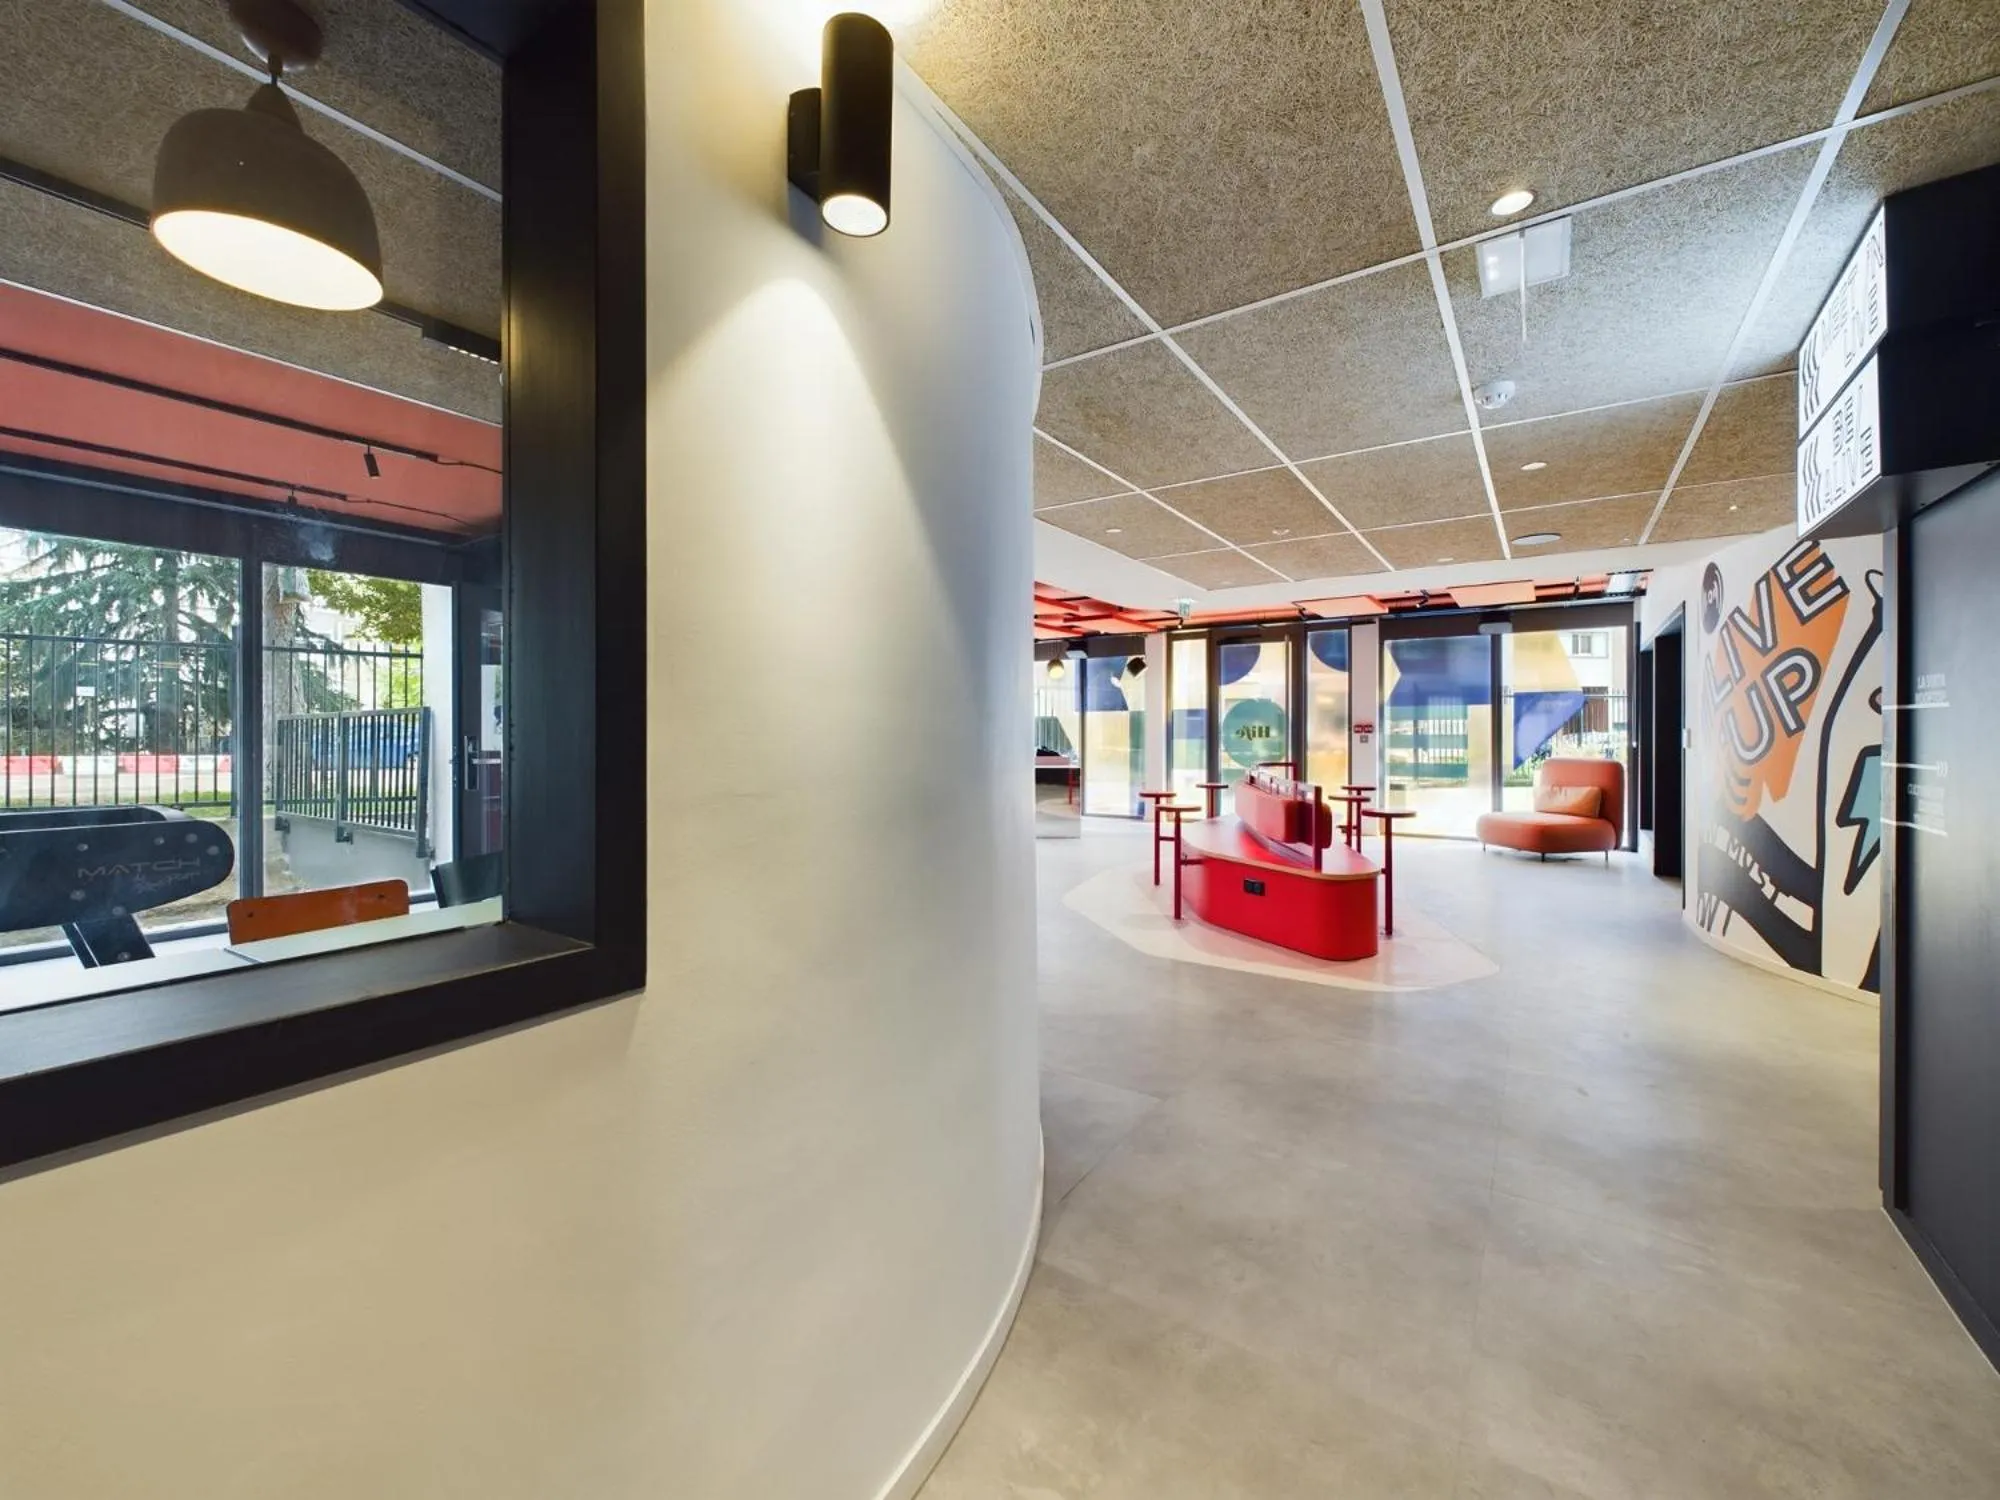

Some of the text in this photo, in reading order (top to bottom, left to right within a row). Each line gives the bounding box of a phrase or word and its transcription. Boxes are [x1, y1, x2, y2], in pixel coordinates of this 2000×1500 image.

[1705, 538, 1850, 712] LIVE
[1725, 648, 1822, 766] UP
[77, 856, 202, 879] MATCH
